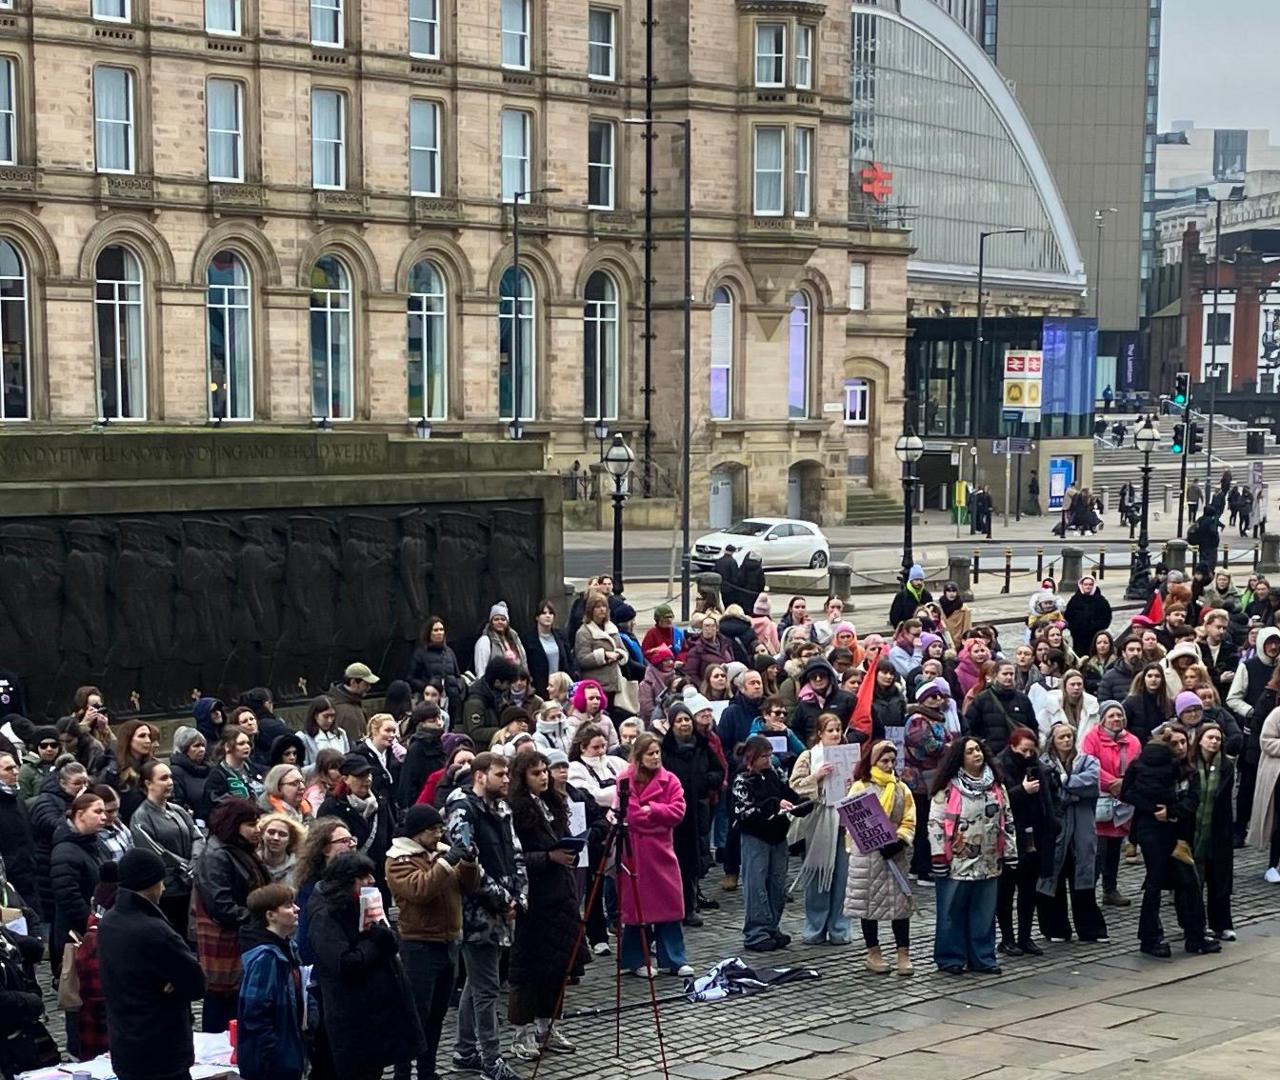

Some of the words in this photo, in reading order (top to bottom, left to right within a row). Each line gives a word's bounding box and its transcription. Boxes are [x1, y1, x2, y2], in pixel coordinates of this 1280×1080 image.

[848, 808, 872, 825] DOWN
[852, 820, 869, 832] THE
[862, 832, 894, 850] SYSTEM
